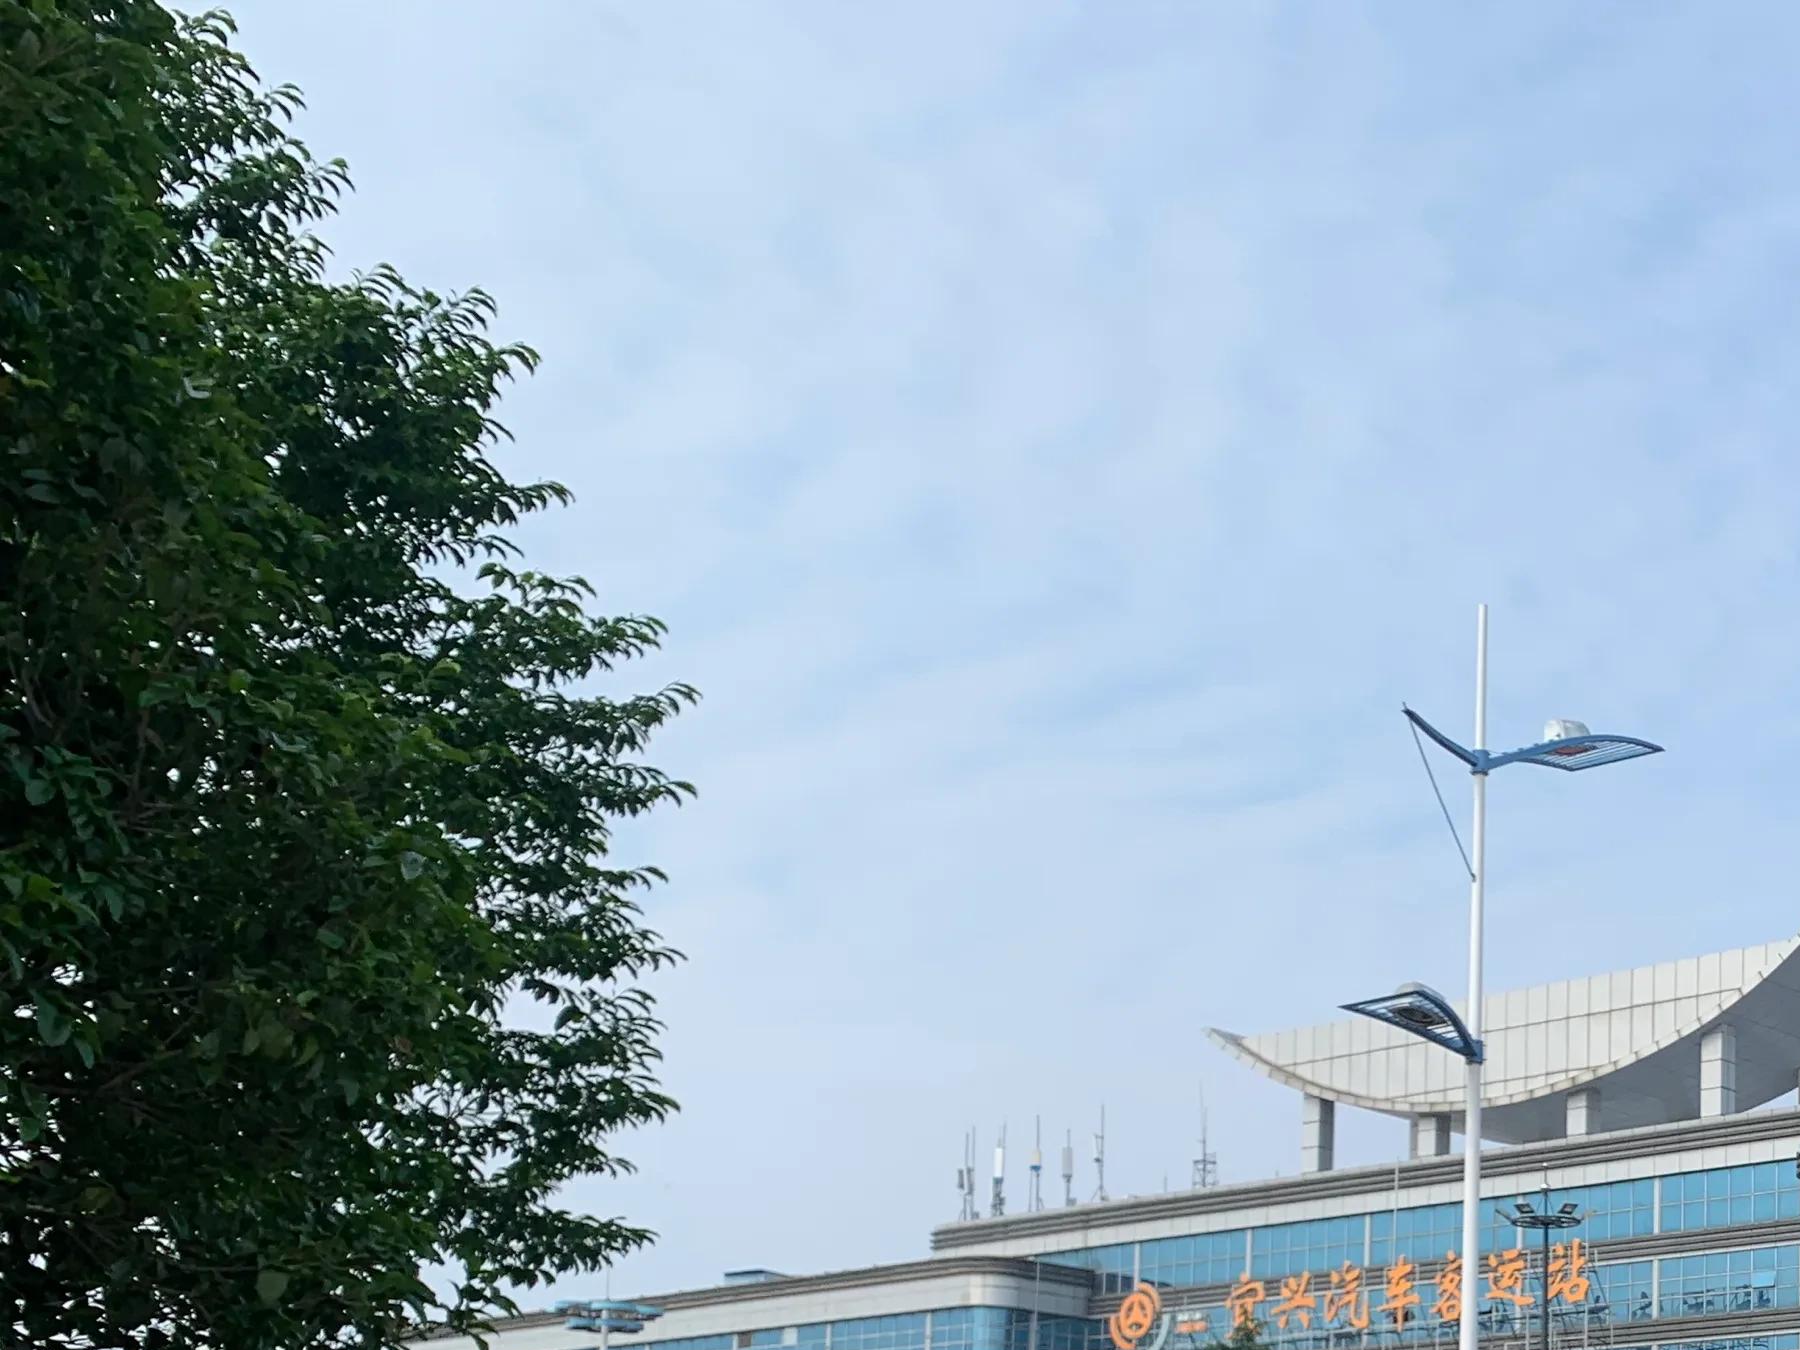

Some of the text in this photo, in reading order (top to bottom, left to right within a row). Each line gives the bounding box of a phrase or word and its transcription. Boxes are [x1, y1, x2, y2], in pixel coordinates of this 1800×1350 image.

[1225, 1239, 1591, 1338] 宜兴汽车客运站
